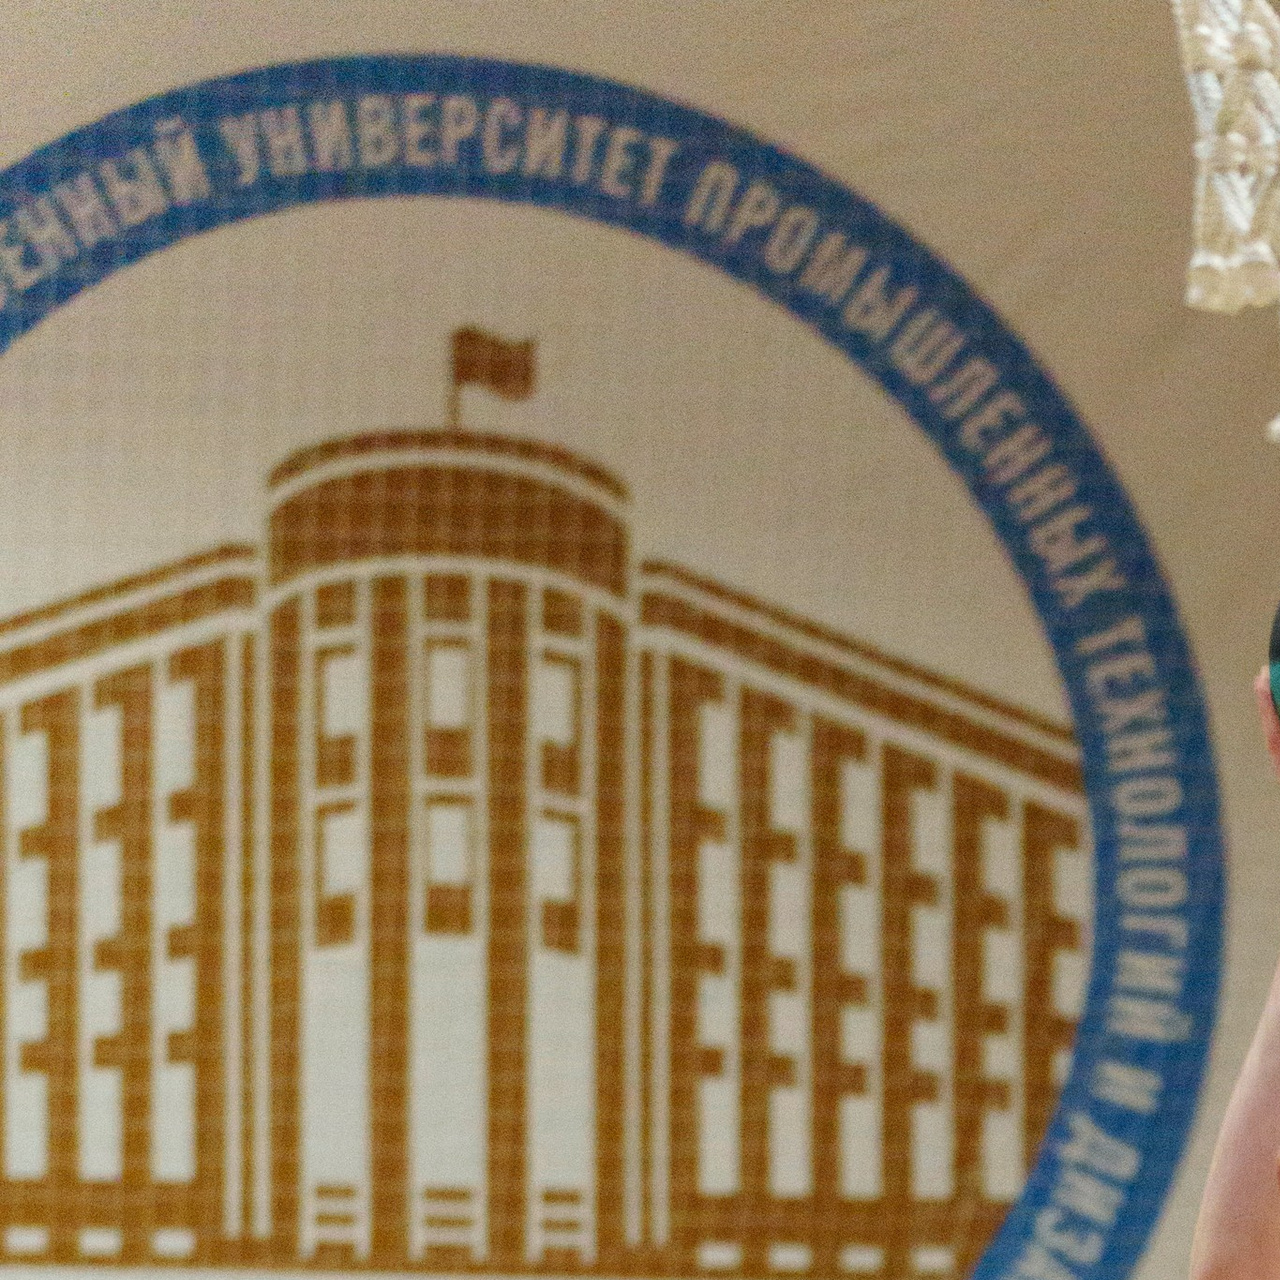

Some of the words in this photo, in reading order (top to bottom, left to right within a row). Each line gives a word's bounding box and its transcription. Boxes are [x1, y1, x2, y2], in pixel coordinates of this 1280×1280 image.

[0, 114, 210, 290] ЕННЫЙ
[219, 93, 679, 204] УНИВЕРСИТЕТ
[684, 160, 1127, 608] ПРОМЫШЛЕННЫХ
[1074, 611, 1193, 1043] ТЕХНОЛОГИЙ
[1088, 1056, 1164, 1111] И
